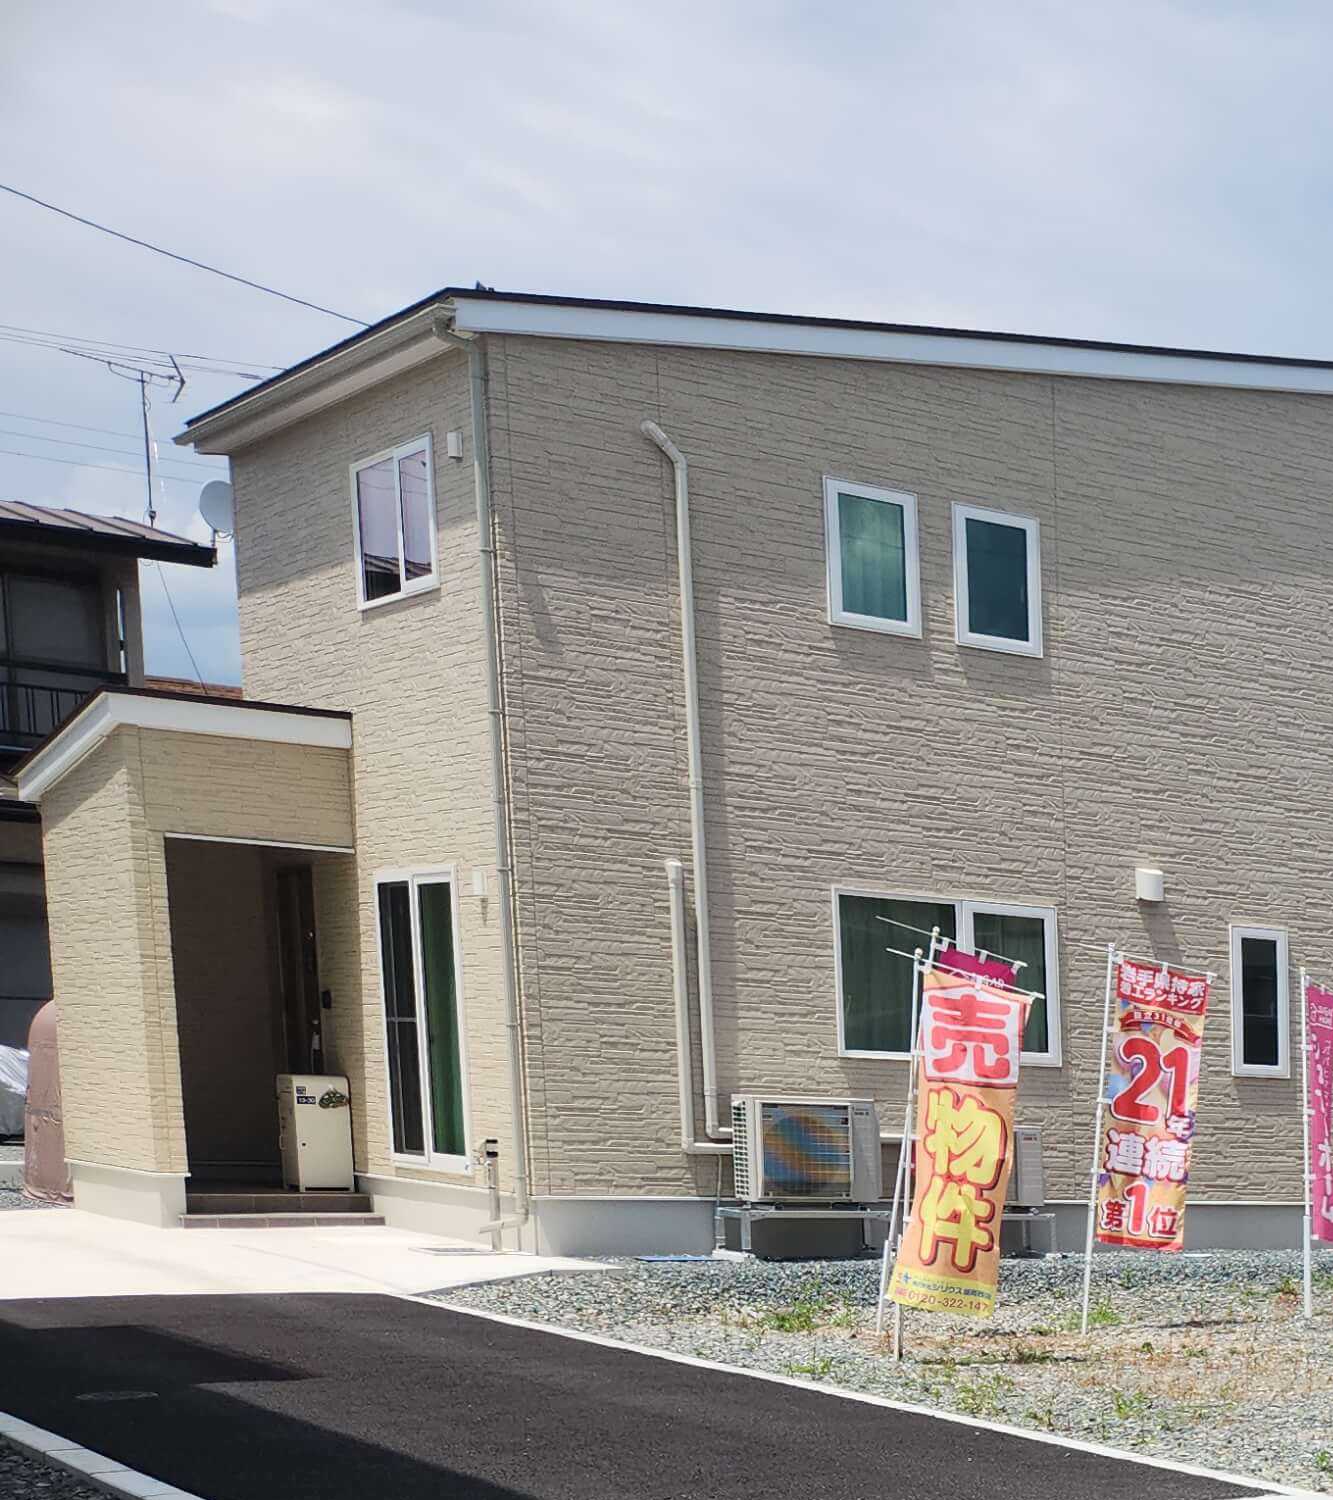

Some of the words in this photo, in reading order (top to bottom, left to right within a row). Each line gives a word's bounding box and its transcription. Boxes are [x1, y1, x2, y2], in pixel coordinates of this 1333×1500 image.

[919, 993, 1012, 1273] 売物件
[1107, 1130, 1189, 1179] 連続
[1103, 1183, 1180, 1237] 第1位
[908, 1290, 989, 1312] 0120-322-147
